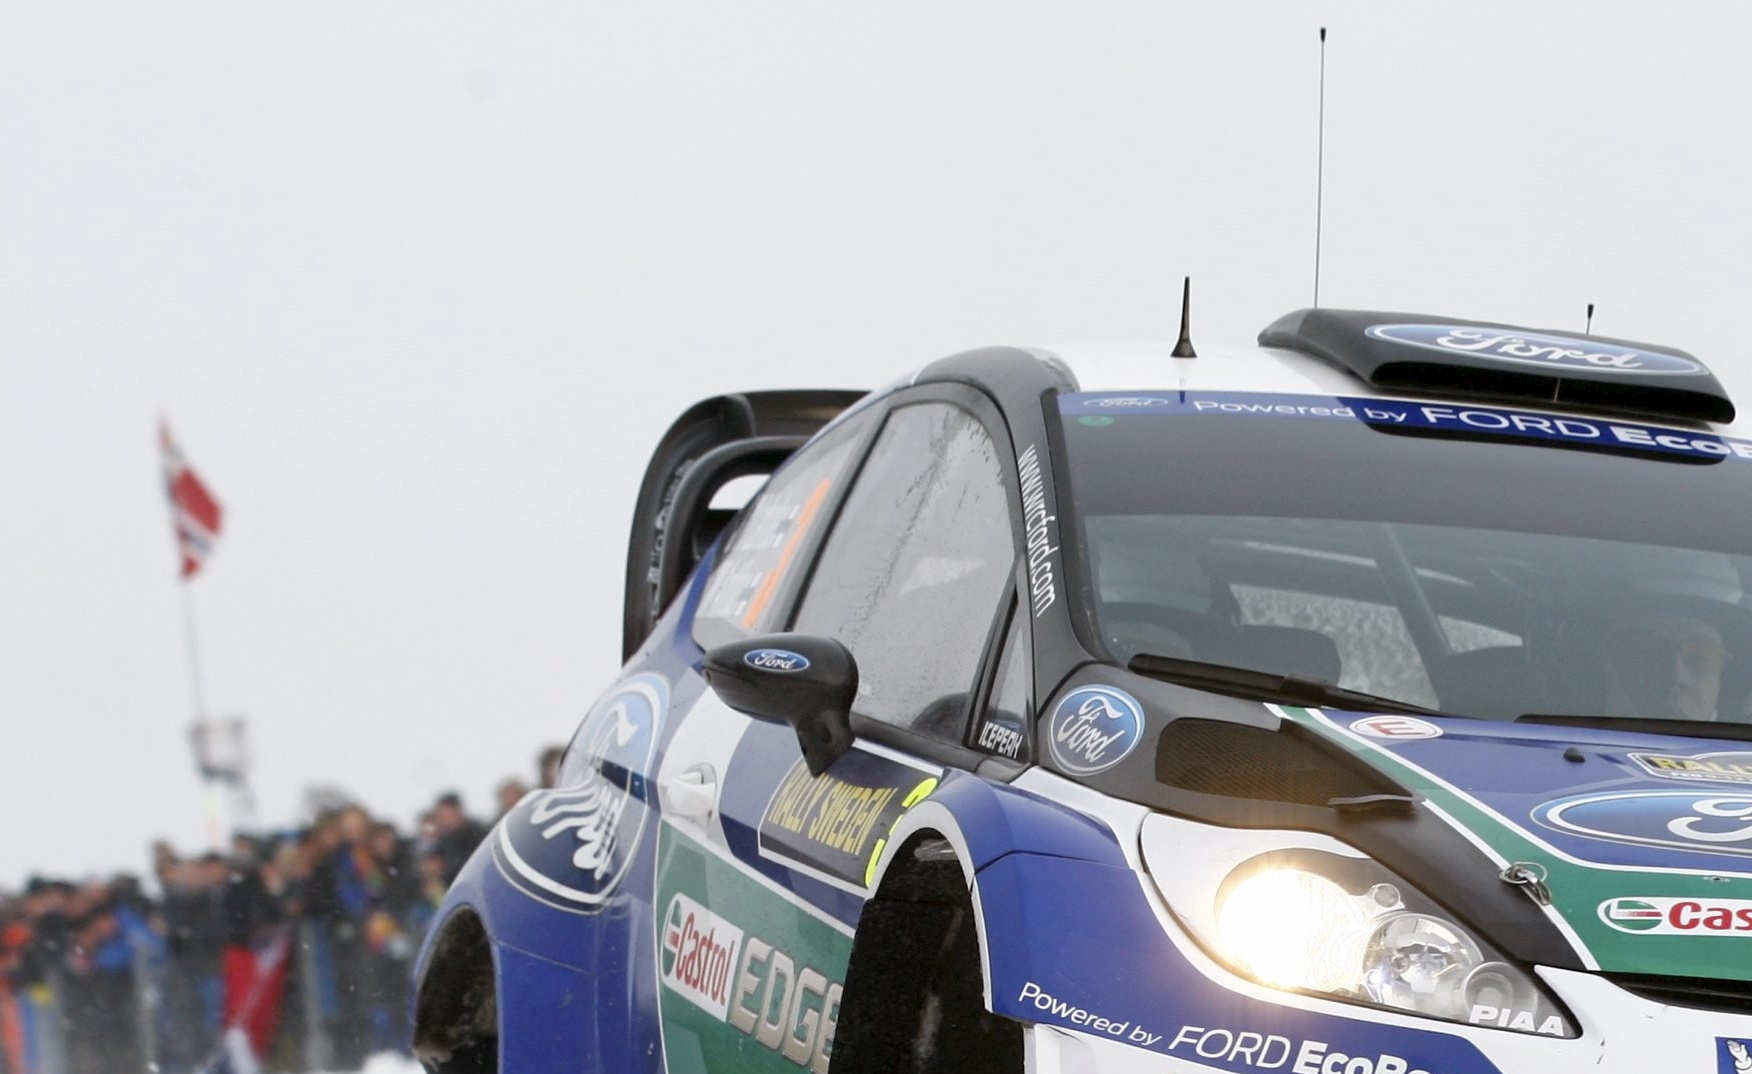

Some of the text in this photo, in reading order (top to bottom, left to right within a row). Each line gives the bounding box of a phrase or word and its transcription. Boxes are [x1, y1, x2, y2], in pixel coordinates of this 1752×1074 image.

[1436, 328, 1642, 369] Ford
[1193, 401, 1355, 418] Powered
[1365, 408, 1406, 424] by
[1421, 407, 1600, 438] FORD
[1018, 443, 1056, 617] www.wrcford.com
[754, 651, 795, 671] Ford
[979, 720, 1024, 760] ICEPEAK
[1056, 696, 1126, 763] Ford
[808, 780, 898, 856] SWEDEN
[676, 912, 735, 1007] Castrol
[1018, 981, 1128, 1037] Powered
[1128, 1020, 1163, 1049] by
[1168, 1025, 1292, 1070] FORD
[1469, 1004, 1564, 1037] PIAA
